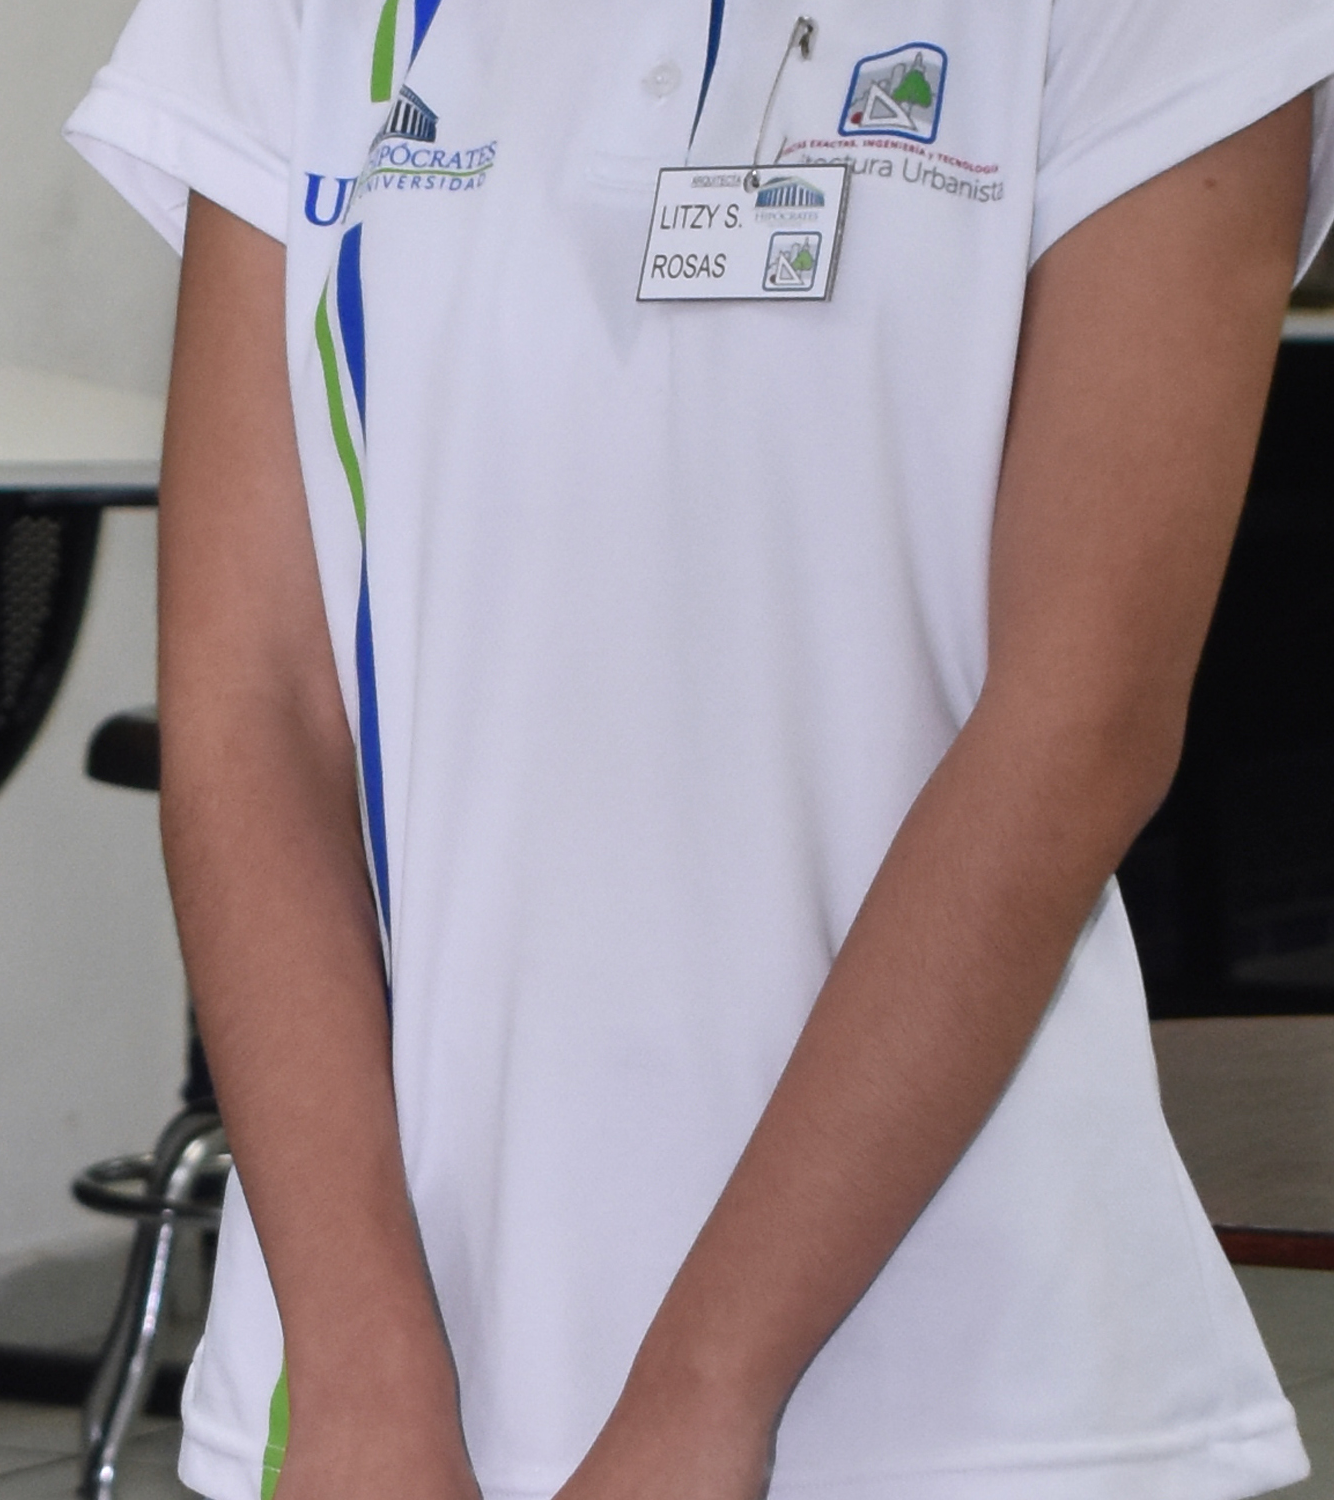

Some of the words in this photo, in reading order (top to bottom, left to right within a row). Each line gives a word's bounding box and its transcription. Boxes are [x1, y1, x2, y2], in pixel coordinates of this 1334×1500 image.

[660, 204, 720, 229] LITZY
[724, 203, 743, 229] S.
[651, 253, 727, 279] ROSAS
